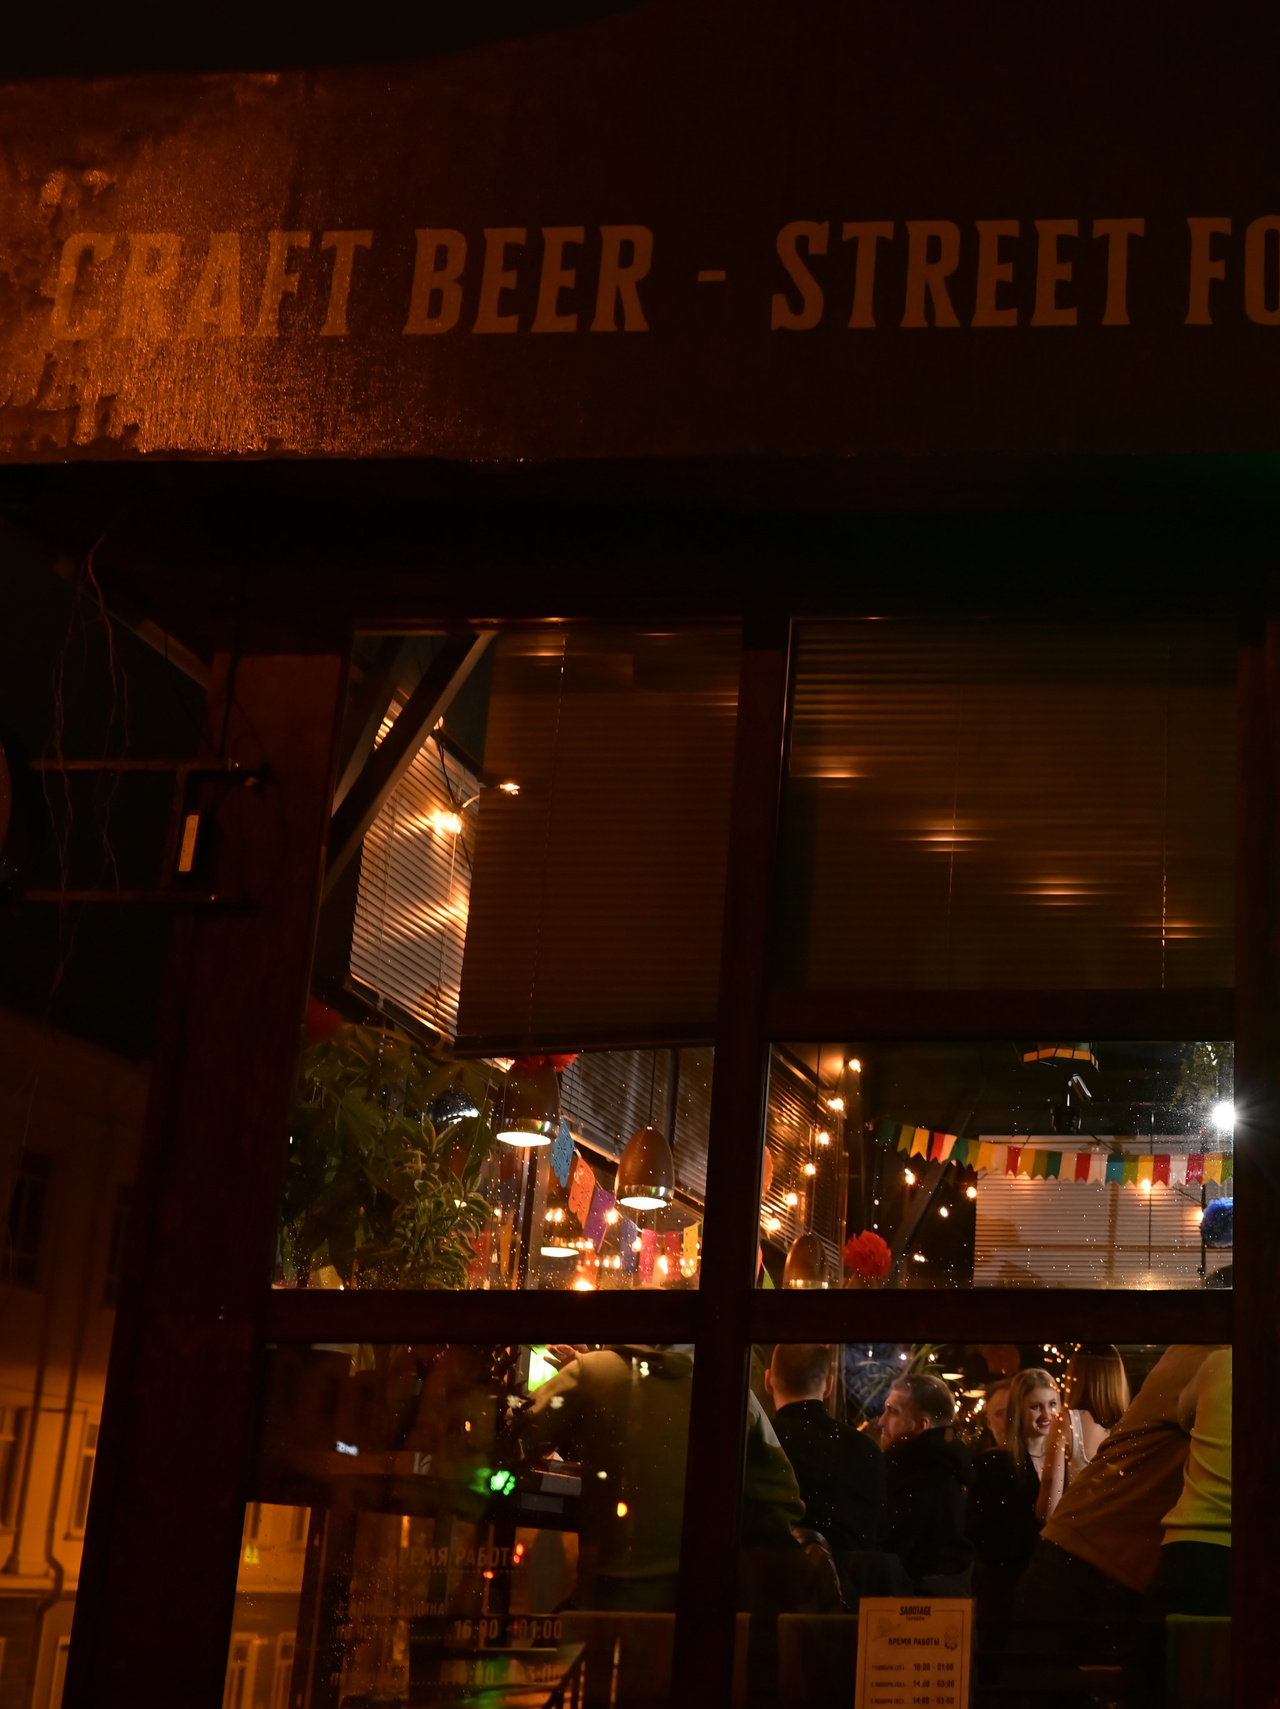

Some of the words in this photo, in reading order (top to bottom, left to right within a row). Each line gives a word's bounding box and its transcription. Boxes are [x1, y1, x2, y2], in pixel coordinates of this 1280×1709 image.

[51, 229, 373, 340] CRAFT
[402, 225, 653, 335] BEER
[770, 218, 1145, 330] STREET
[900, 1606, 932, 1616] SABOTAGE
[888, 1638, 911, 1646] ВРЕМЯ
[913, 1637, 940, 1646] РАБОТЫ
